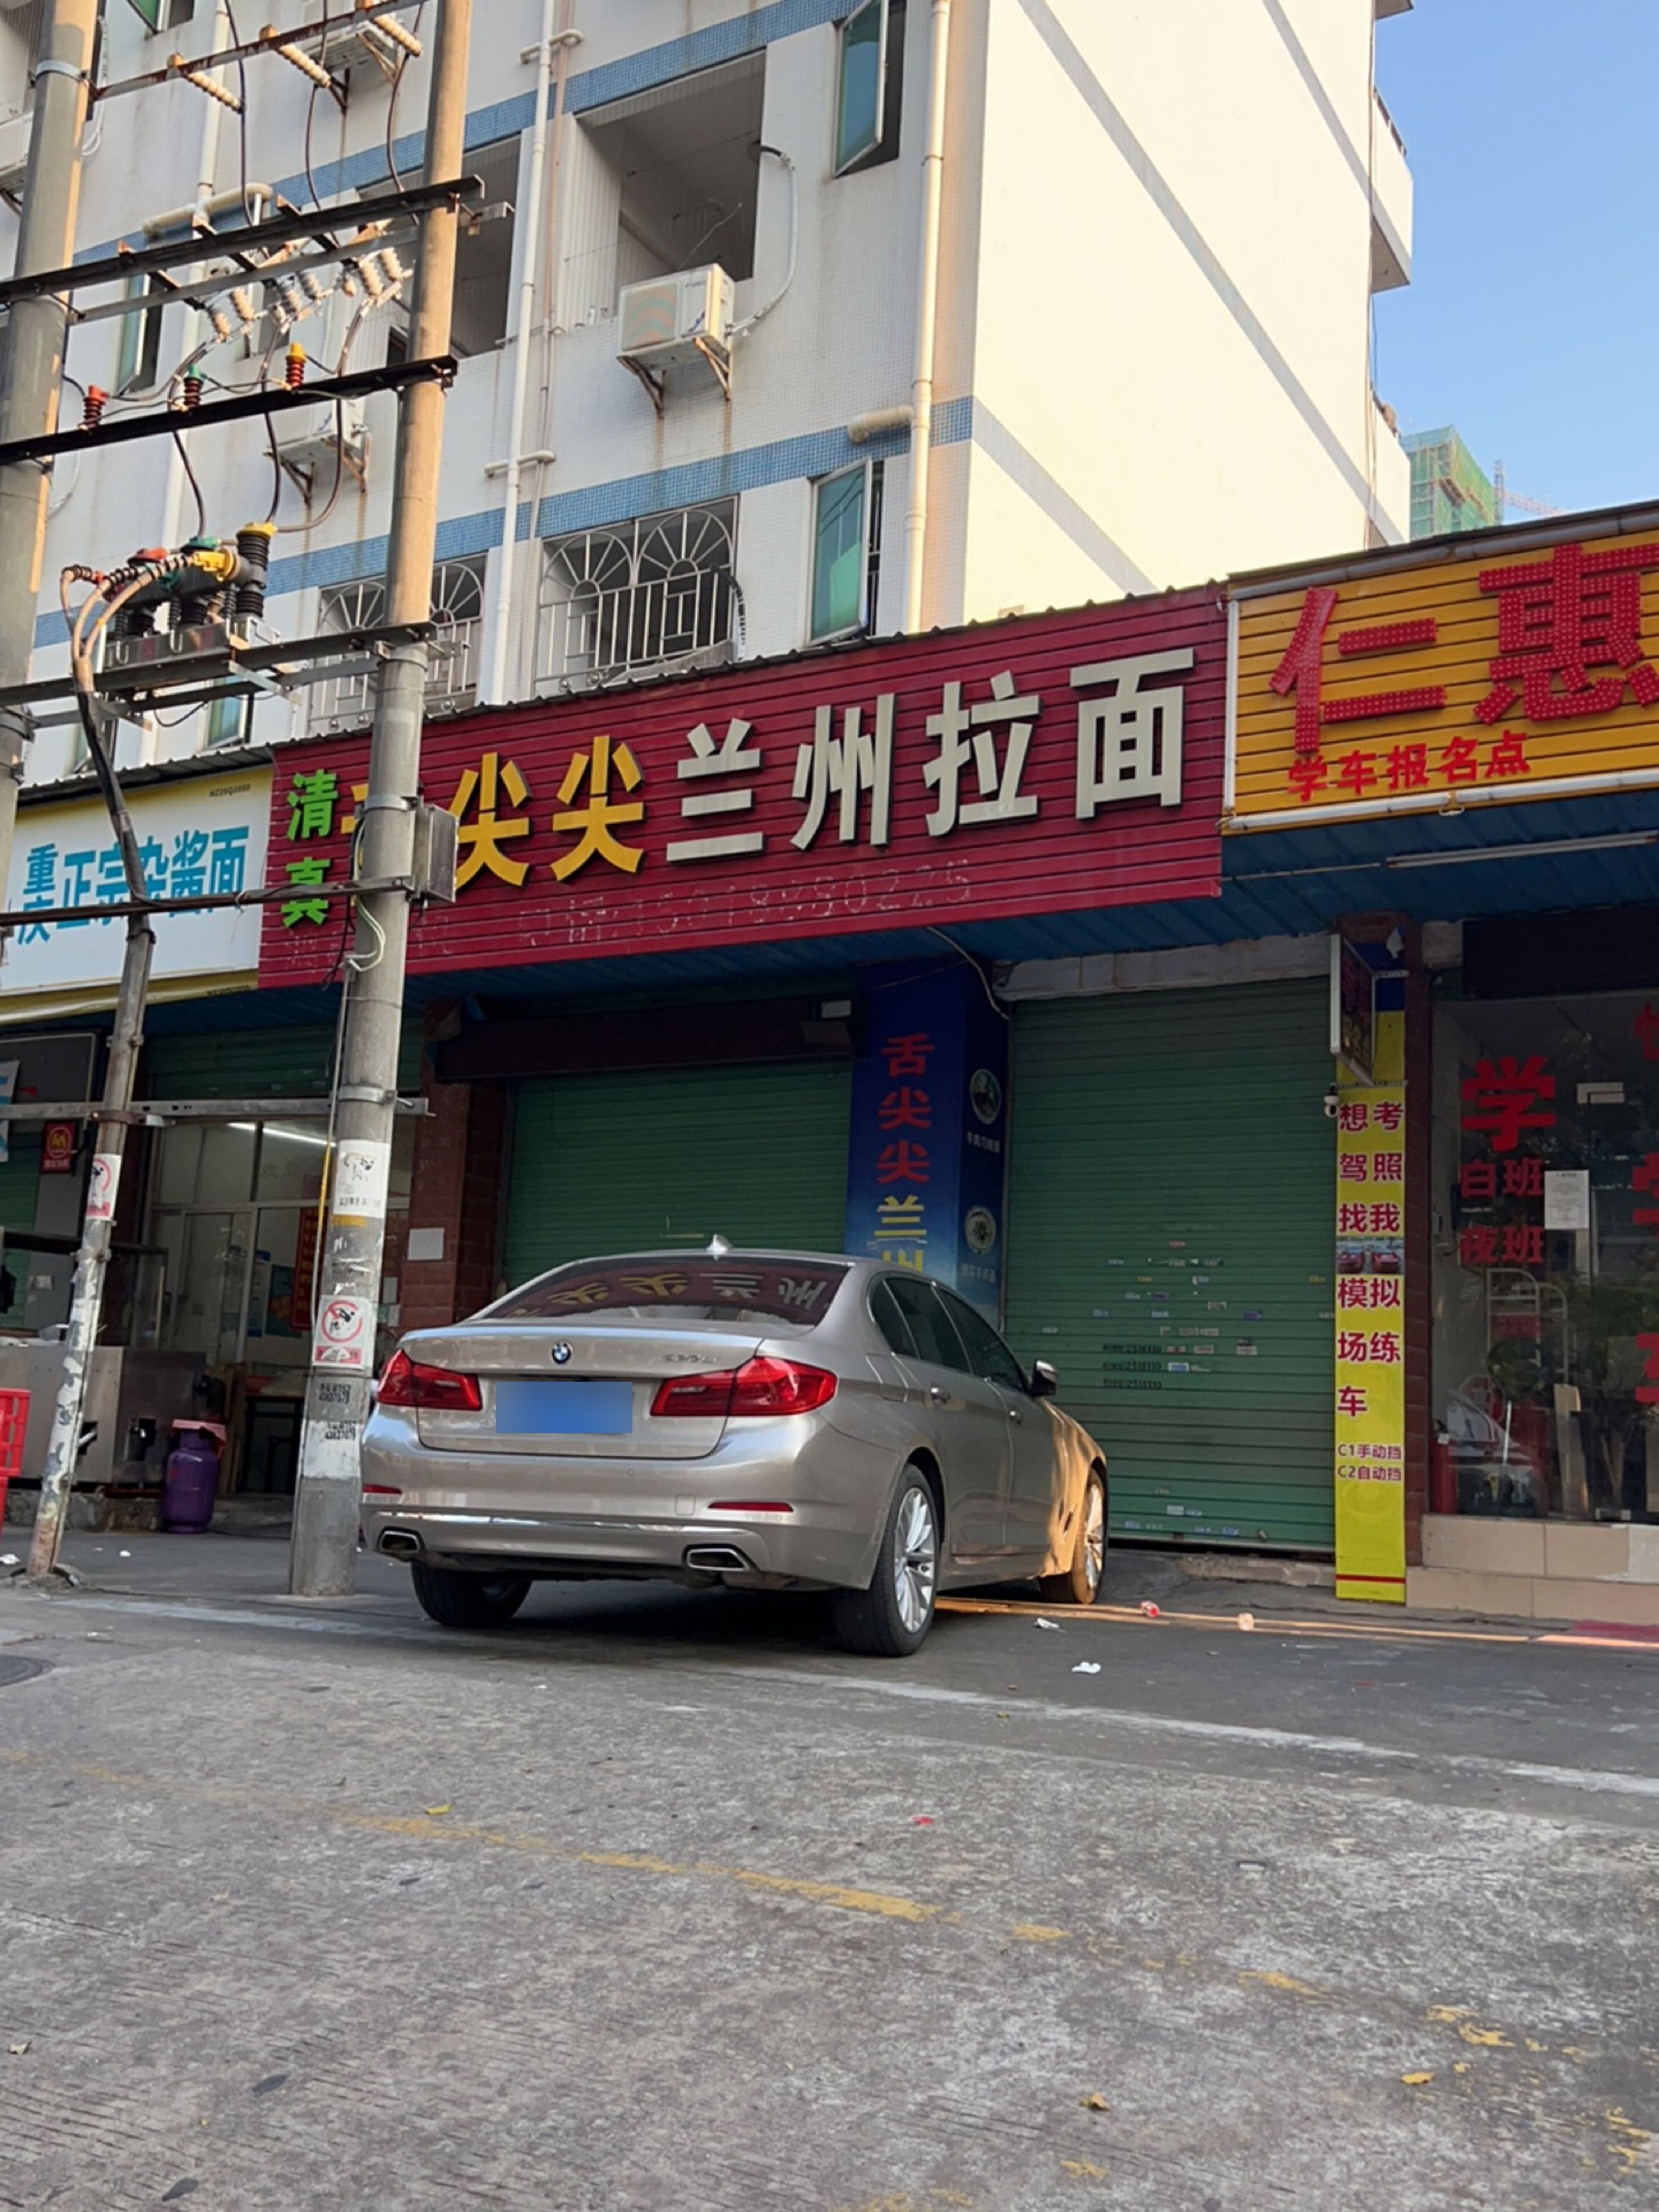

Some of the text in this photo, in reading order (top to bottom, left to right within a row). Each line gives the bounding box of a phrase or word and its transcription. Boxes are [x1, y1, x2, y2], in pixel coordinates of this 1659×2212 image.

[1269, 543, 1659, 754] 仁惠
[341, 648, 1194, 890] 尖尖兰州拉面
[1287, 729, 1532, 802] 学车报名点
[282, 769, 339, 927] 清真
[1339, 1101, 1404, 1133] 想考
[1461, 1055, 1556, 1153] 学
[1339, 1152, 1403, 1182] 驾照
[1461, 1157, 1544, 1199] 白班
[1338, 1203, 1400, 1233] 找我
[1460, 1225, 1544, 1266] 夜班
[1337, 1278, 1400, 1309] 模拟
[1337, 1332, 1401, 1363] 场练
[1337, 1386, 1368, 1418] 车
[1337, 1443, 1402, 1459] C1手动挡
[1337, 1465, 1402, 1481] C2自动挡
